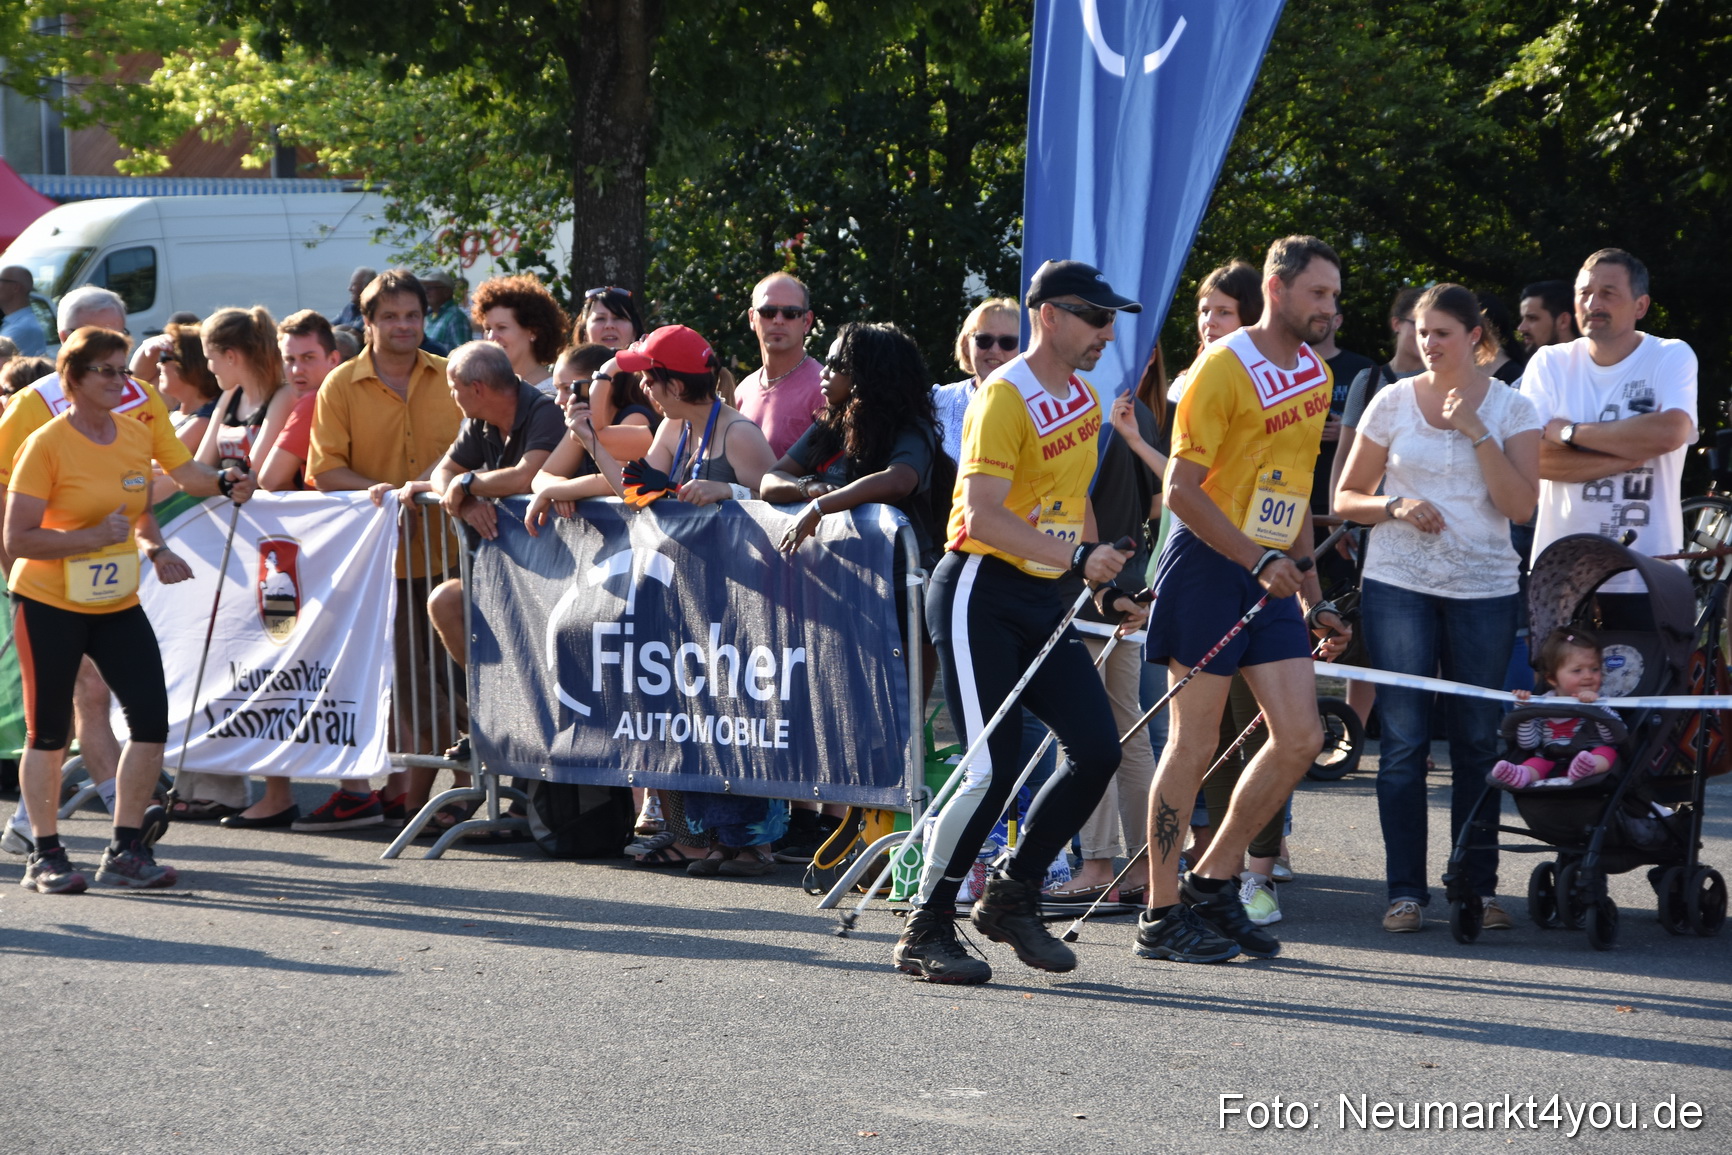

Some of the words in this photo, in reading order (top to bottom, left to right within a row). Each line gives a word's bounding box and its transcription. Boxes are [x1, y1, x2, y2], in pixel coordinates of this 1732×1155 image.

[1265, 405, 1303, 435] MAX
[1042, 431, 1078, 461] MAX
[1260, 497, 1296, 528] 901
[89, 562, 119, 587] 72
[229, 659, 332, 693] Neumarkter
[592, 622, 806, 701] Fischer
[204, 698, 358, 748] Lammsbräu
[612, 711, 790, 749] AUTOMOBILE
